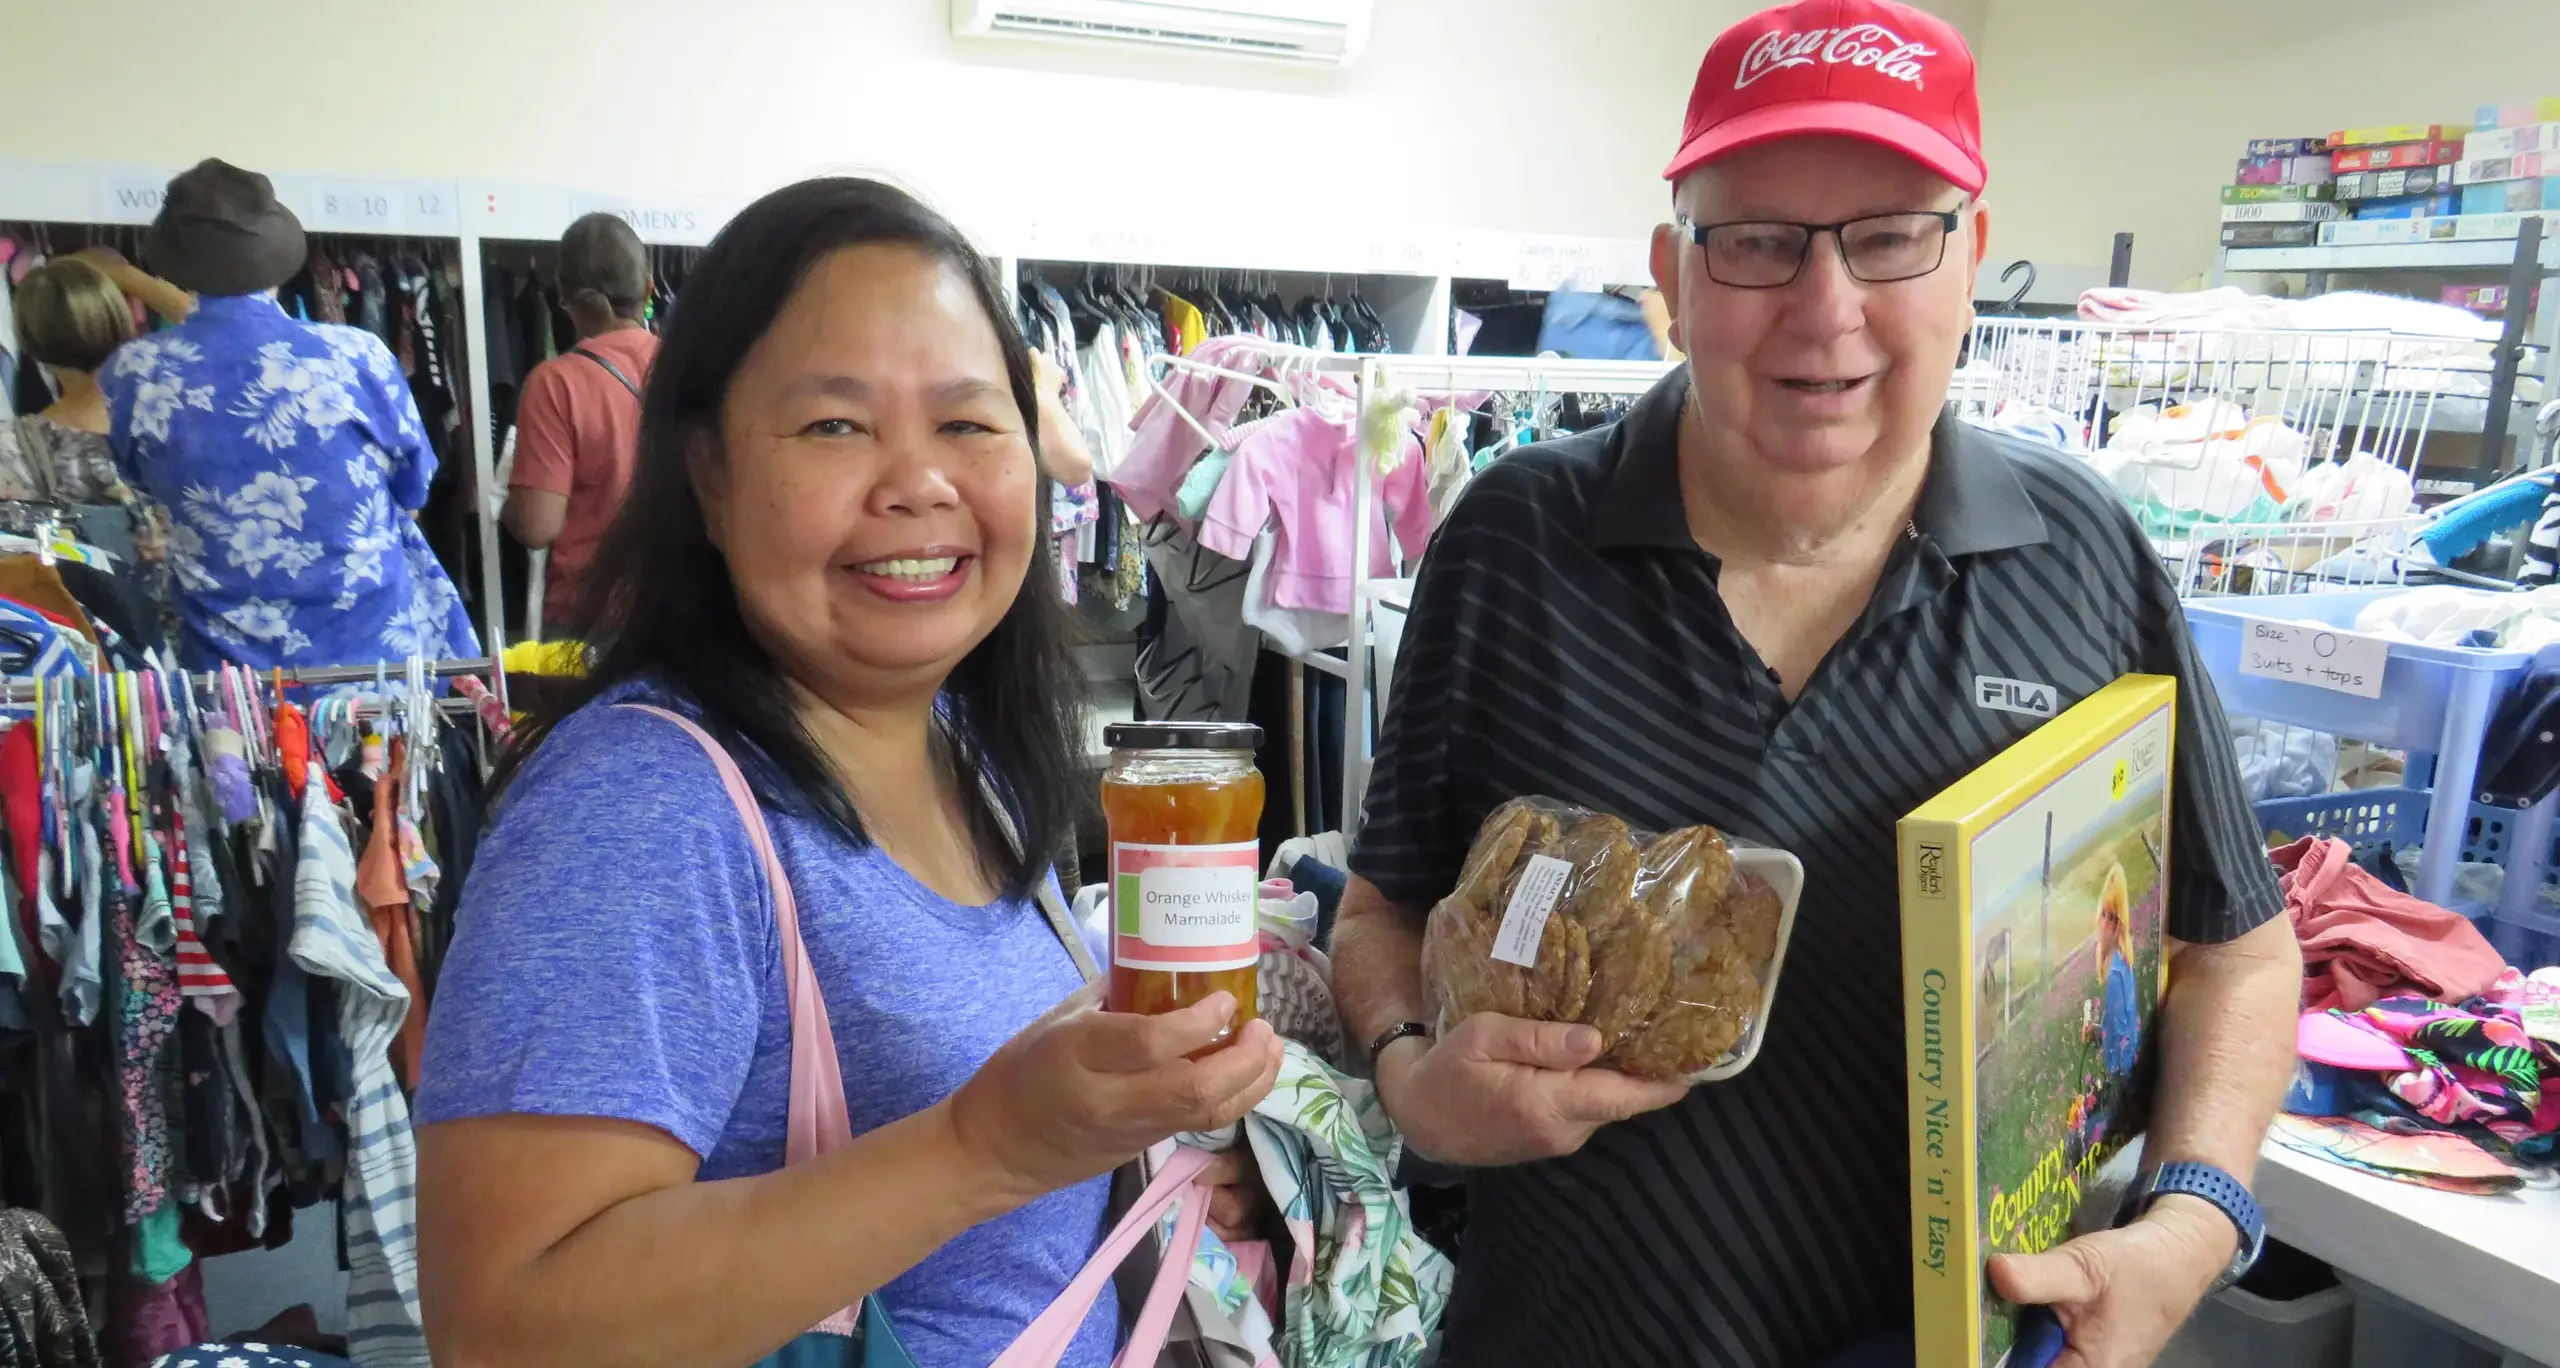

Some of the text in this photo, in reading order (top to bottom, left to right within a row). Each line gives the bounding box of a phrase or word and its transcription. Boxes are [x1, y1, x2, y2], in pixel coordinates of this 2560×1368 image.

[363, 196, 388, 216] 10
[418, 195, 441, 215] 12
[2234, 203, 2330, 220] 1000 1000
[2255, 624, 2289, 643] Size
[2251, 652, 2294, 674] Suits
[2320, 666, 2363, 686] tops
[1983, 682, 2049, 712] FILA
[1146, 890, 1200, 909] Orange
[1164, 910, 1242, 926] Marmalade
[1917, 967, 1947, 1089] Country
[1923, 1096, 1949, 1159] Nice
[1989, 1138, 2065, 1247] Country
[2017, 1203, 2060, 1255] Nice
[1921, 1214, 1950, 1277] Easy
